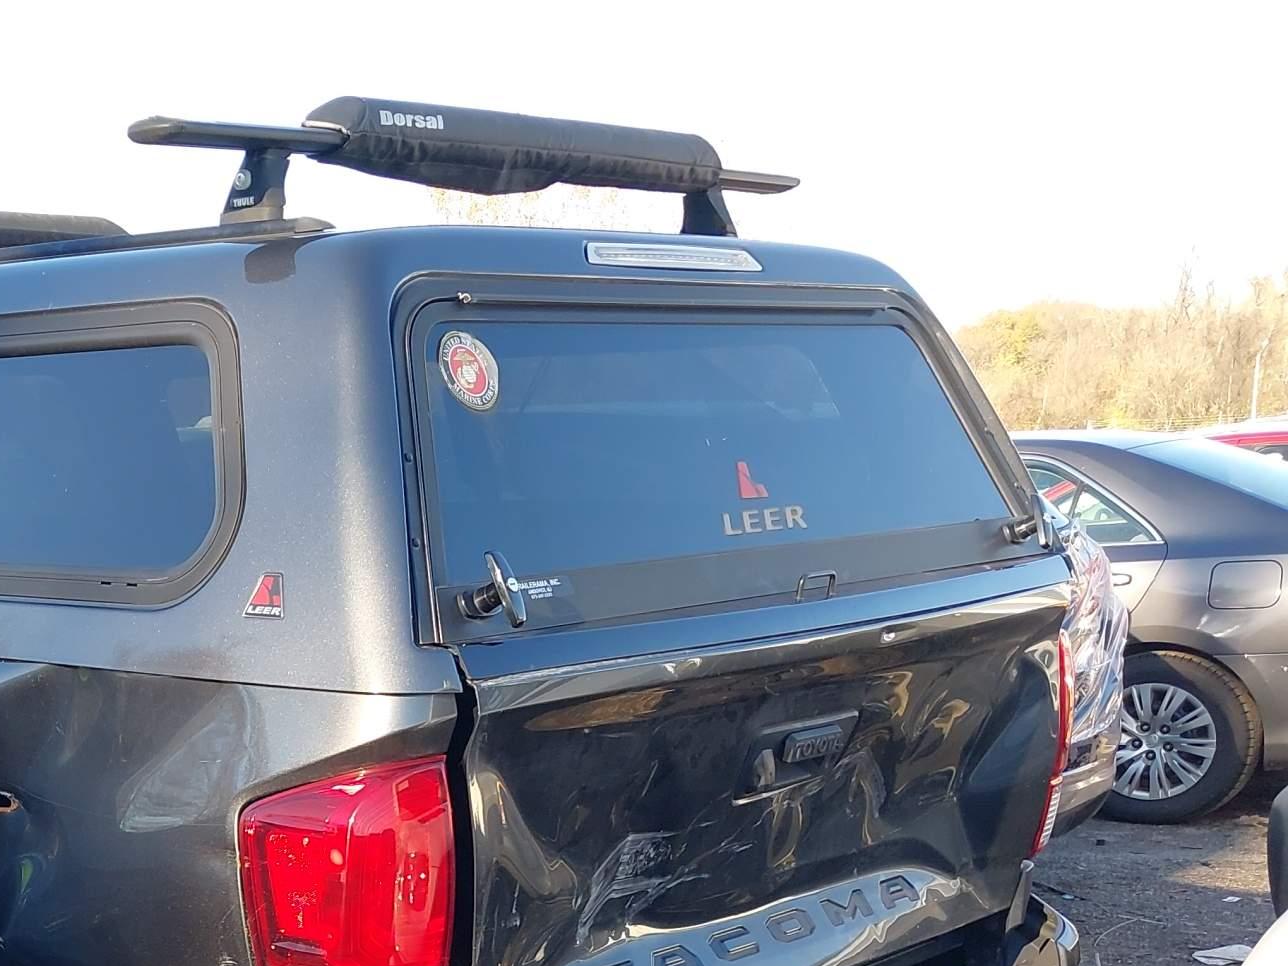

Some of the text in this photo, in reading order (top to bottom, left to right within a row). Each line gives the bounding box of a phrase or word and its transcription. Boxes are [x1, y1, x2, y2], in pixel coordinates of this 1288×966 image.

[379, 109, 445, 130] Dorsal
[233, 196, 255, 207] THULE
[453, 383, 483, 405] MARINE
[722, 504, 808, 537] LEER
[246, 605, 281, 615] LEER
[795, 734, 843, 760] TOYOTA
